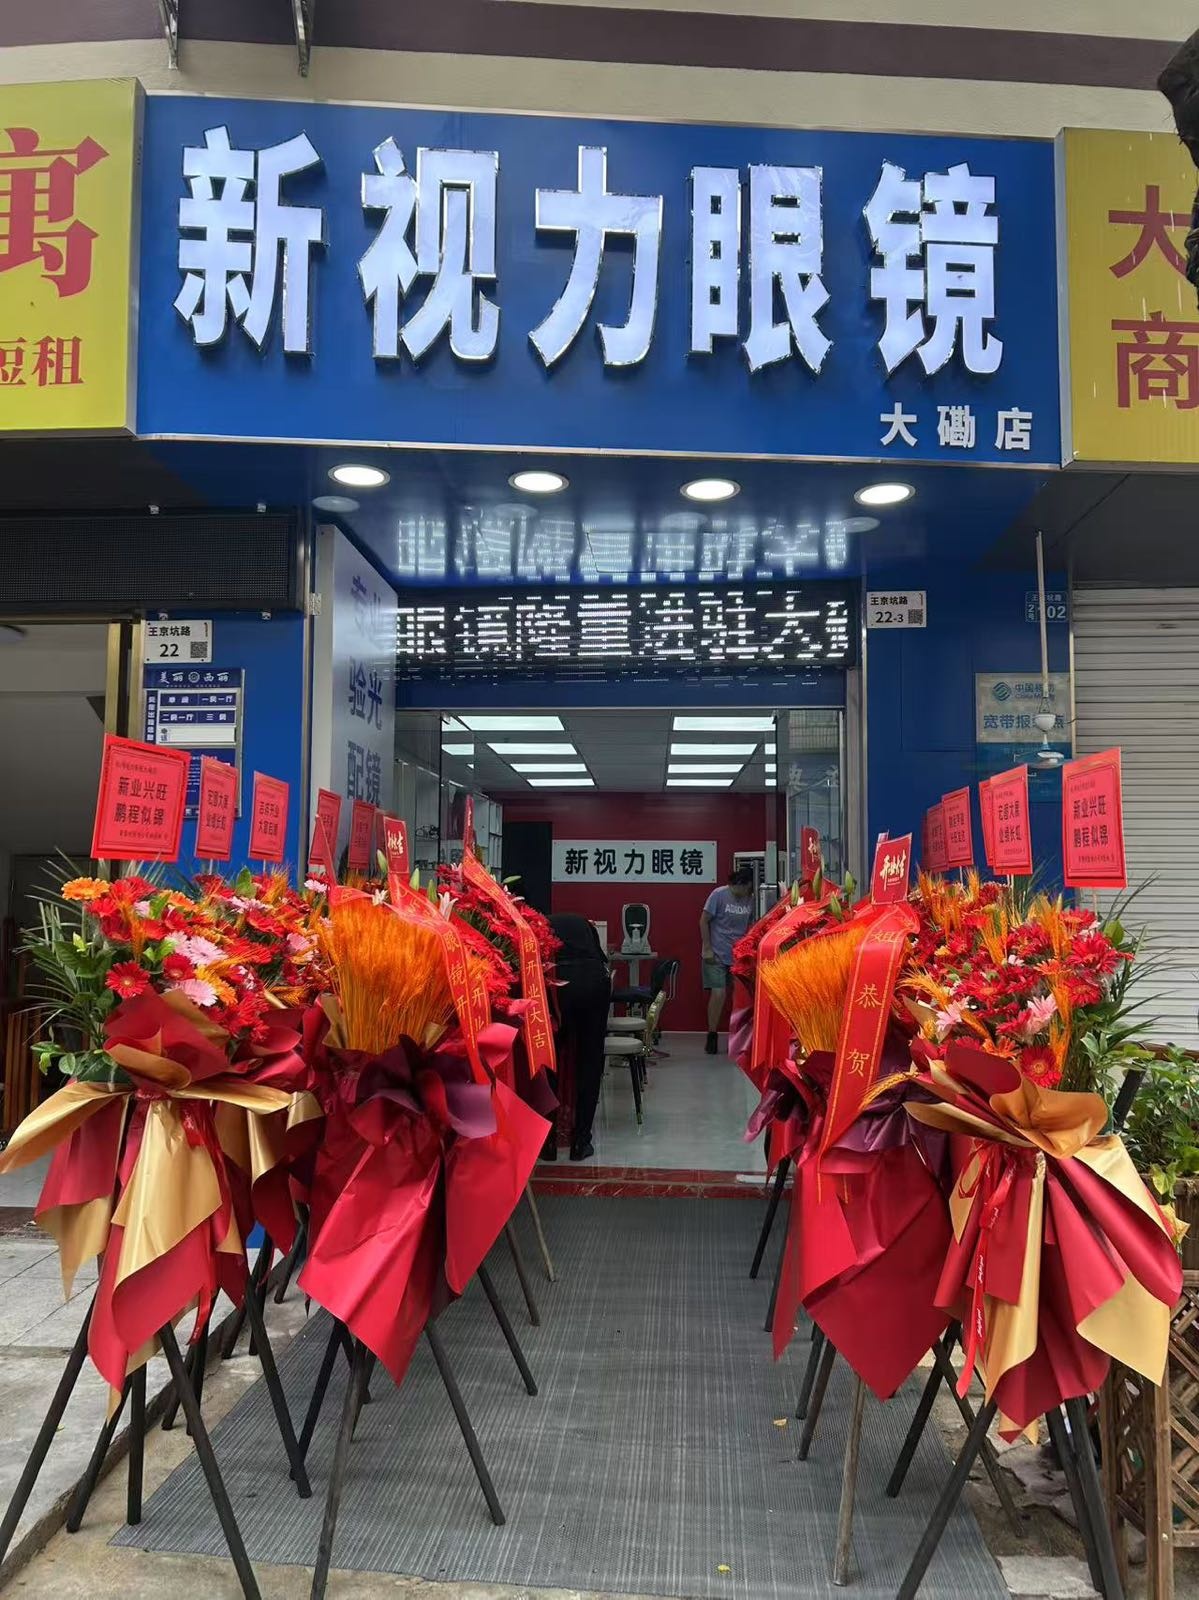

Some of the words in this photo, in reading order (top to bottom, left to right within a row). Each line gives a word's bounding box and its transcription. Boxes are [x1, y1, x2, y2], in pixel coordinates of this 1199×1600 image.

[1108, 185, 1187, 279] 大
[174, 124, 1003, 376] 新视力眼镜
[1111, 310, 1199, 410] 商
[880, 402, 1033, 452] 大磡店
[870, 596, 908, 606] 王京坑路
[875, 611, 904, 623] 22-3
[148, 627, 191, 637] 王京坑路
[159, 643, 180, 657] 22
[348, 656, 383, 731] 验光
[983, 714, 1065, 730] 宽带报点
[347, 740, 381, 808] 配镜
[117, 776, 169, 801] 新业兴旺
[113, 803, 165, 826] 鹏程似锦
[1073, 795, 1107, 820] 新业兴旺
[1073, 824, 1109, 848] 鹏程似锦
[564, 848, 704, 876] 新视力眼镜
[845, 982, 883, 1078] 恭贺
